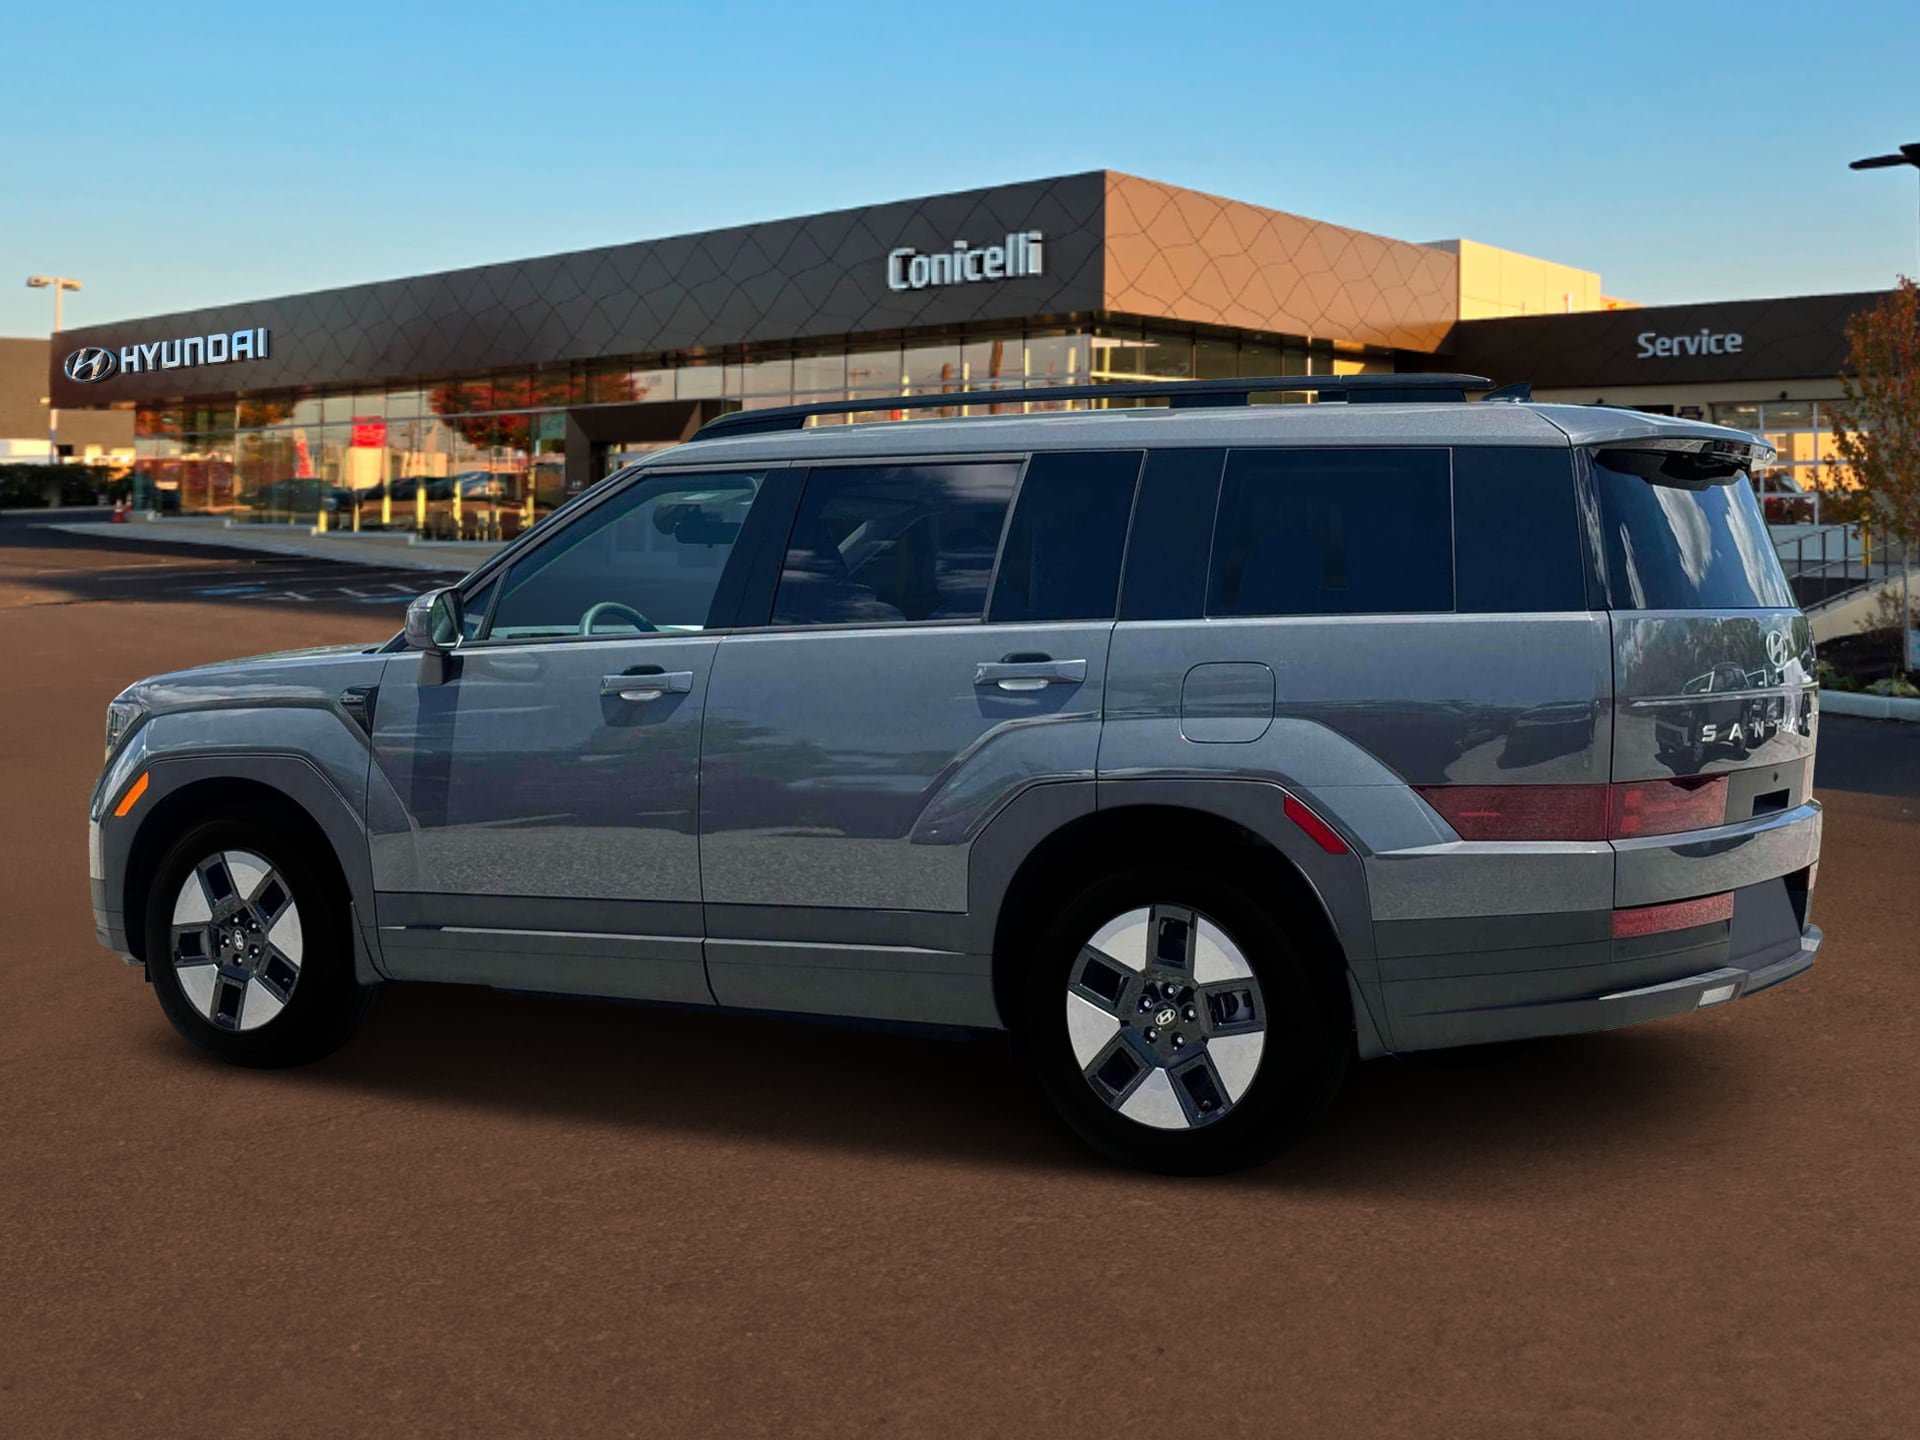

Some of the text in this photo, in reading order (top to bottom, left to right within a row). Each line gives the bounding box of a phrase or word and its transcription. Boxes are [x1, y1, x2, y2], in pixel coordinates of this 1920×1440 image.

[888, 231, 1042, 290] Conicelli
[120, 327, 267, 374] HYUNDAI
[1637, 328, 1742, 358] Service
